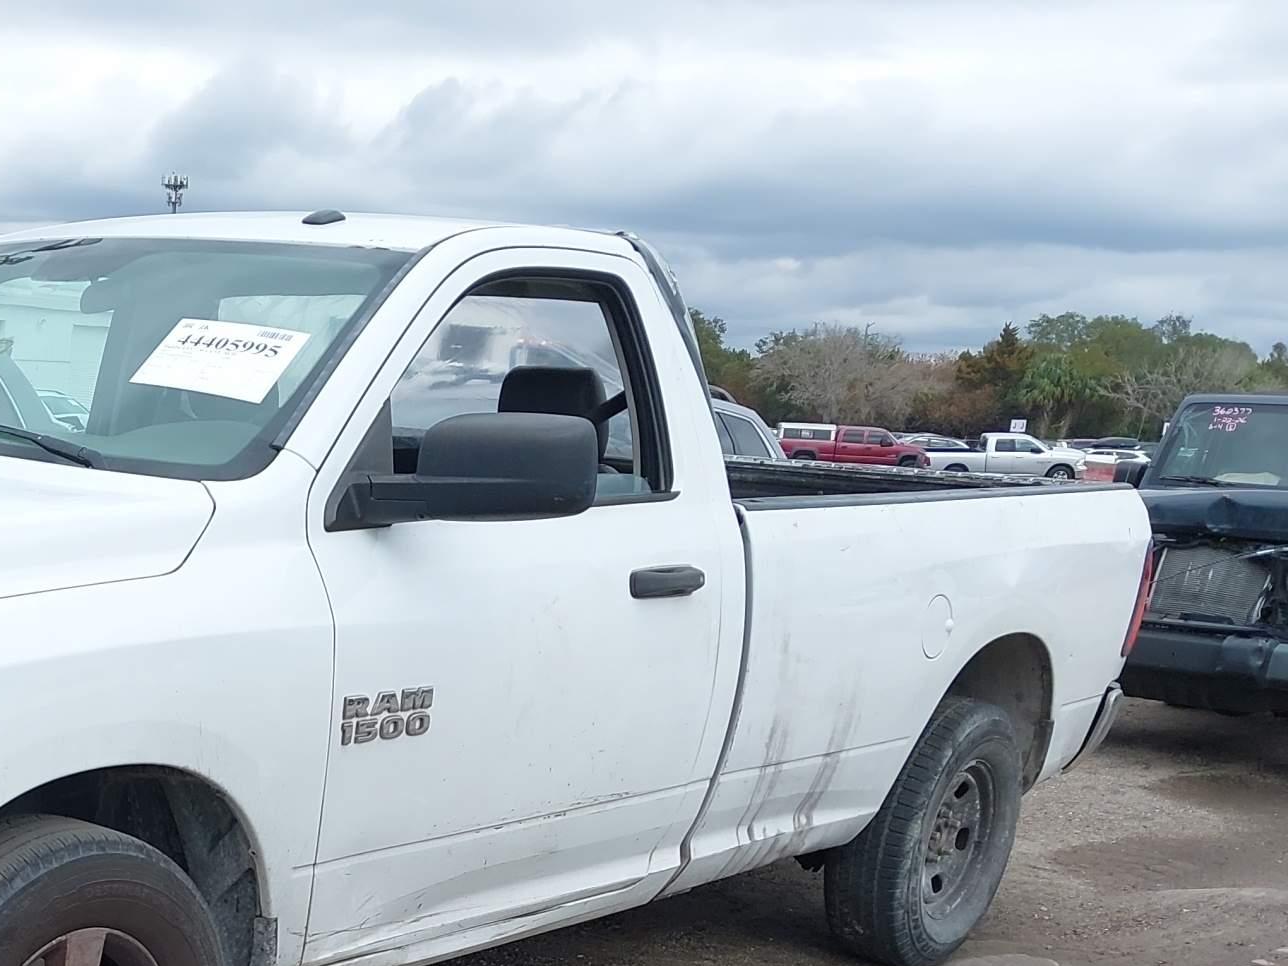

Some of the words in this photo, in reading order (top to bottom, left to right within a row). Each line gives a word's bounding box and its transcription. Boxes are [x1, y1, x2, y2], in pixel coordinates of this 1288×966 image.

[177, 334, 283, 358] 44405995
[342, 686, 434, 721] RAM
[340, 711, 431, 746] 1500
